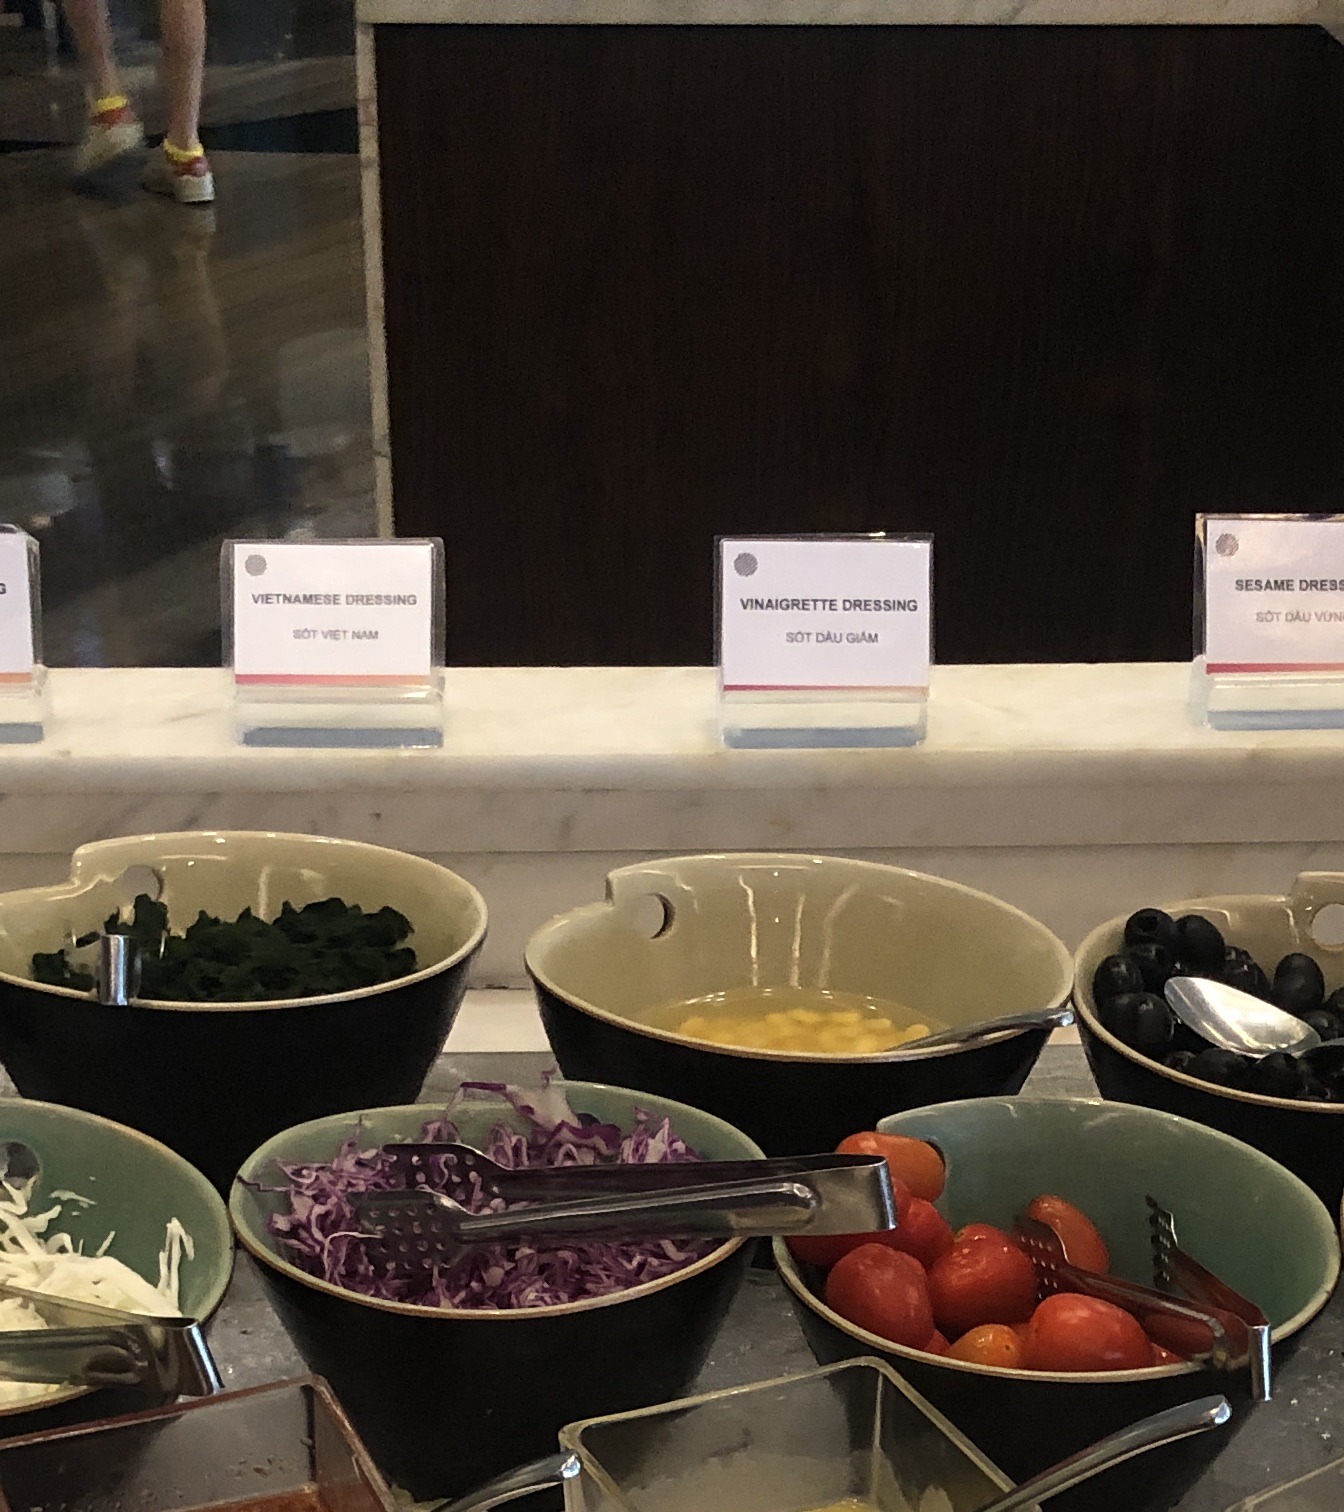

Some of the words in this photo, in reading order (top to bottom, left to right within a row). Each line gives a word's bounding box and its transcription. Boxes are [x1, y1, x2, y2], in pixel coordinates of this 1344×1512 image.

[1235, 578, 1295, 592] SESAME
[252, 593, 342, 605] VIETNAMESE
[345, 594, 418, 606] DRESSING
[740, 598, 838, 612] VINAIGRETTE
[842, 599, 918, 612] DRESSING
[351, 630, 379, 640] NAM
